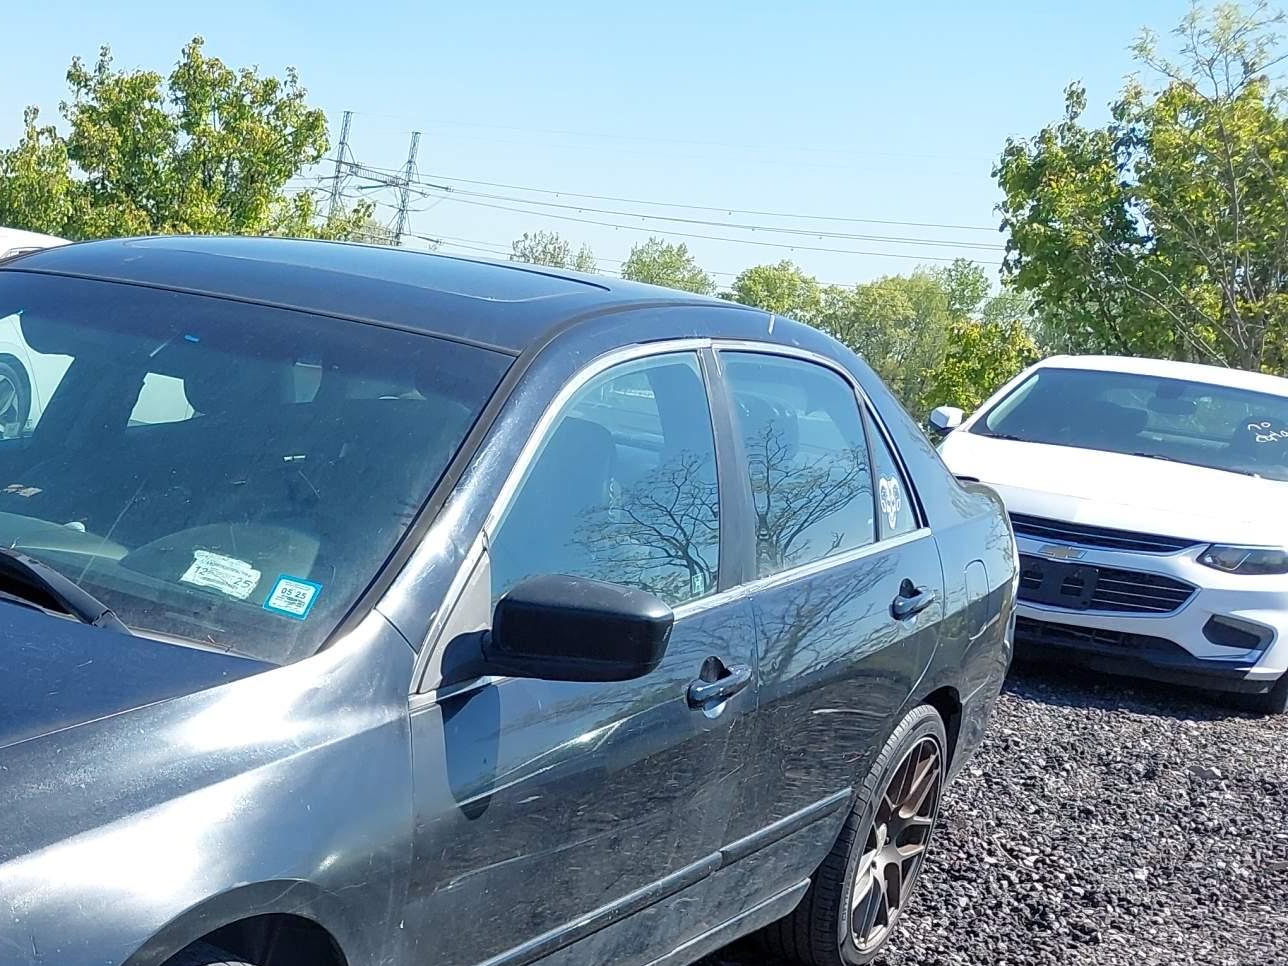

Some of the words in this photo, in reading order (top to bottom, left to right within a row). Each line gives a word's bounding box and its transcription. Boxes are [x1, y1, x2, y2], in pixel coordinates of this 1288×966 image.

[194, 566, 209, 576] 12
[233, 577, 253, 589] 25
[281, 587, 293, 596] 05
[295, 591, 307, 600] 25
